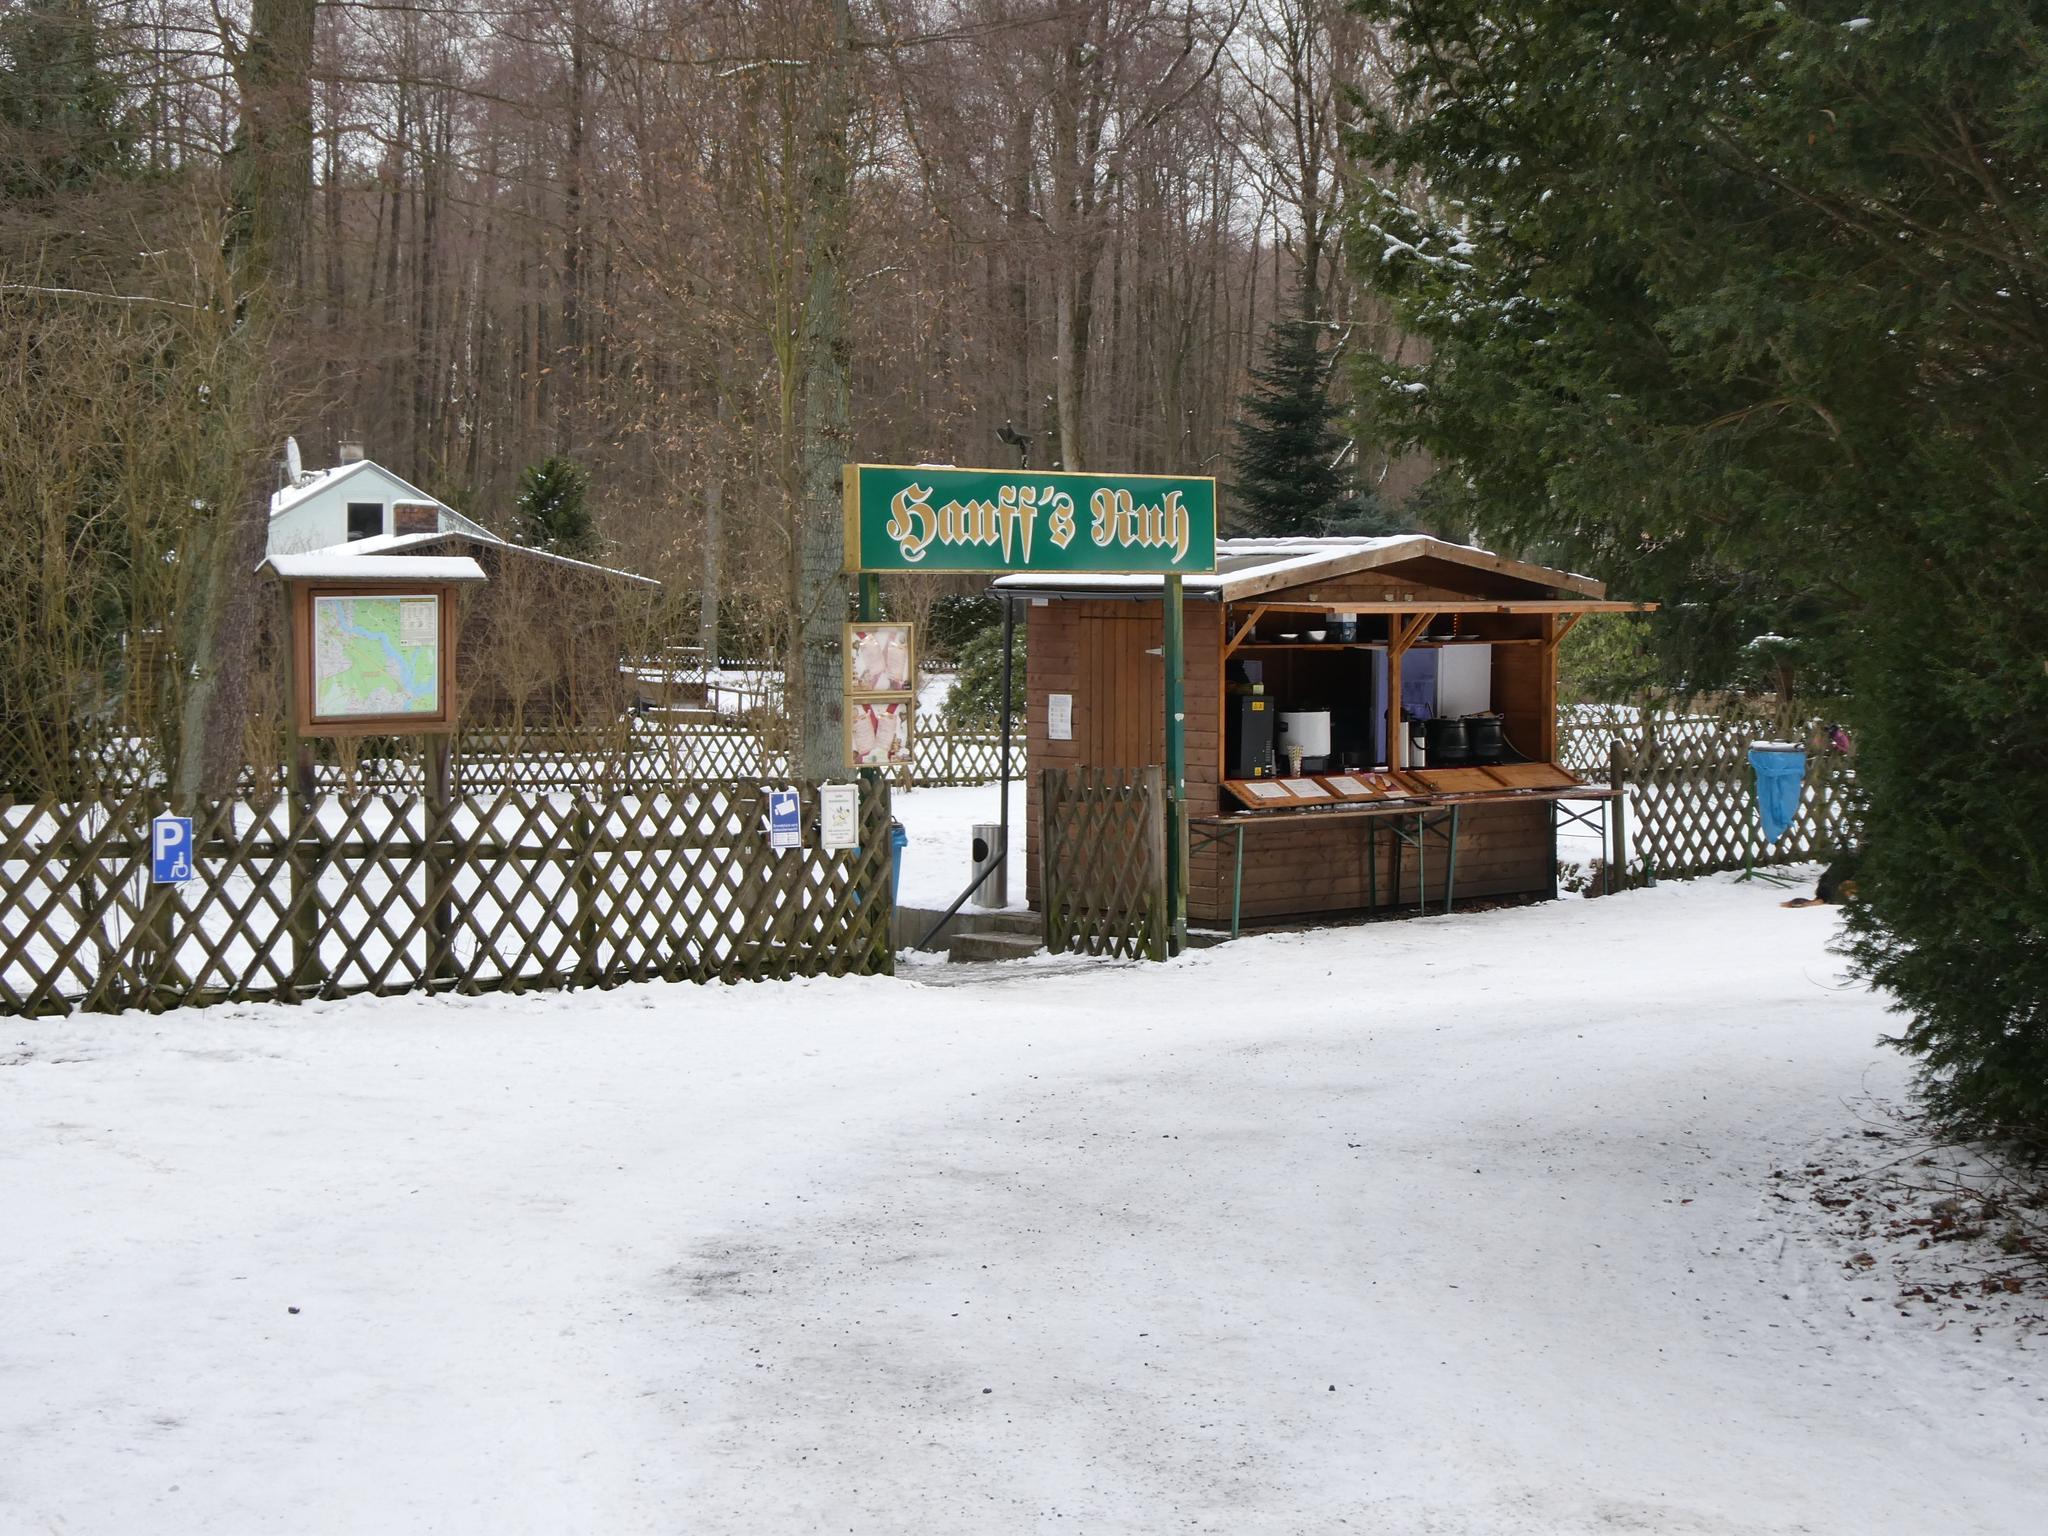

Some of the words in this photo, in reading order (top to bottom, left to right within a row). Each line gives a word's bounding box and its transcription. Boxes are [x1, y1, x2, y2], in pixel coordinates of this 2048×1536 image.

[886, 482, 1076, 564] Hanff's
[1090, 487, 1190, 564] Ruh
[156, 821, 184, 860] P
